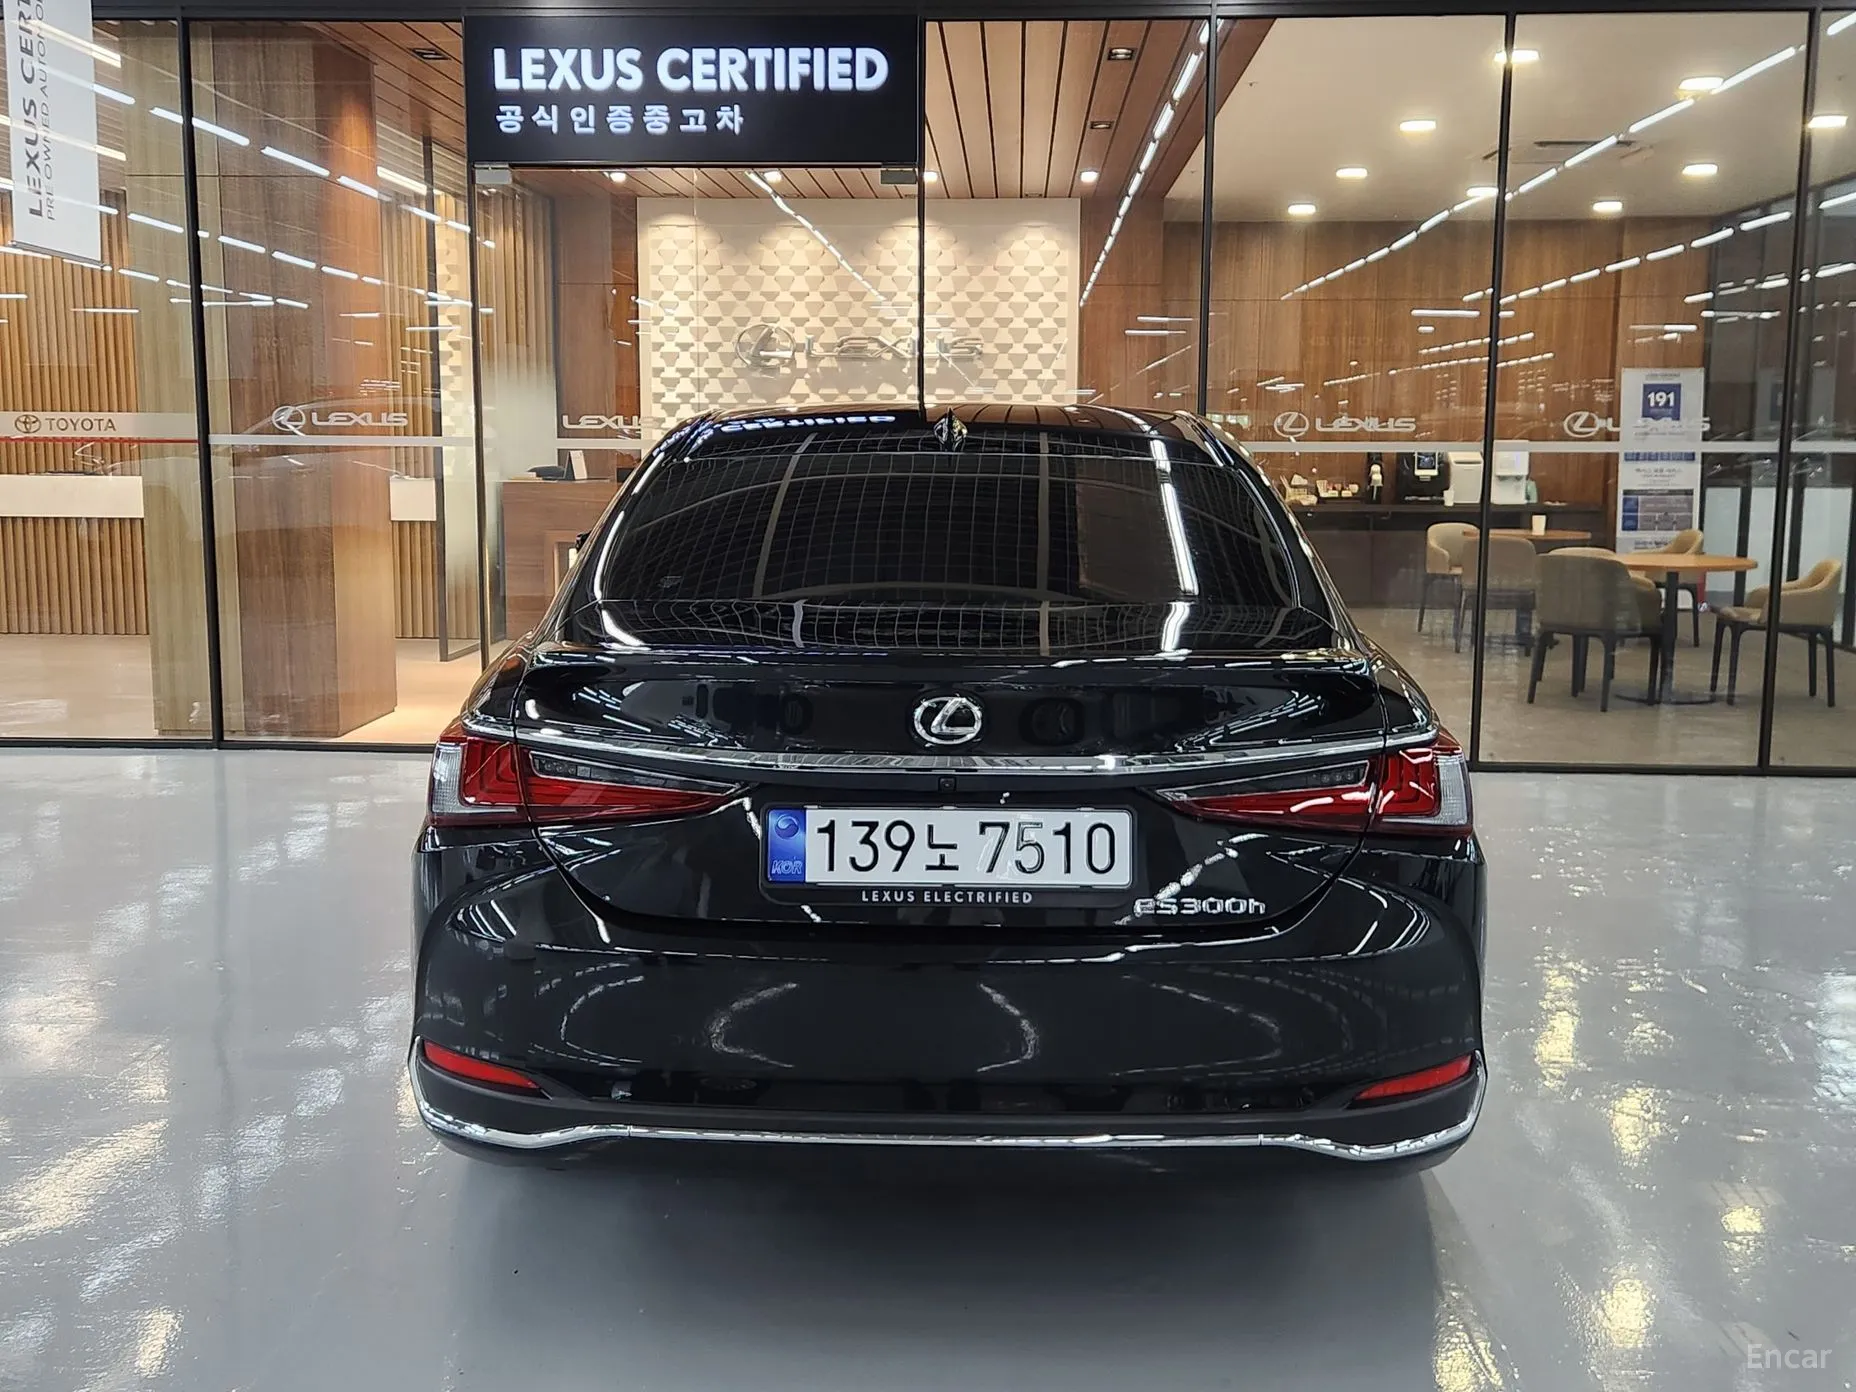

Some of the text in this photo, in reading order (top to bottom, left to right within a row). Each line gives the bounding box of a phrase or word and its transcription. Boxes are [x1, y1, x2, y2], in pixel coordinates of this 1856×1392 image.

[492, 46, 889, 92] LEXUS CERTIFIED
[495, 104, 744, 135] 공식인증중고차
[23, 98, 43, 217] LEXUS
[804, 335, 983, 359] LEXUS
[1647, 391, 1675, 407] 191
[45, 417, 117, 433] TOYOTA
[311, 411, 409, 427] LEXUS
[1315, 416, 1417, 433] LEXUS
[816, 818, 1116, 875] 139노 7510
[771, 859, 803, 876] KOR
[861, 890, 1033, 904] LEXUS ELECTRIFIED
[1133, 897, 1266, 917] ES300h
